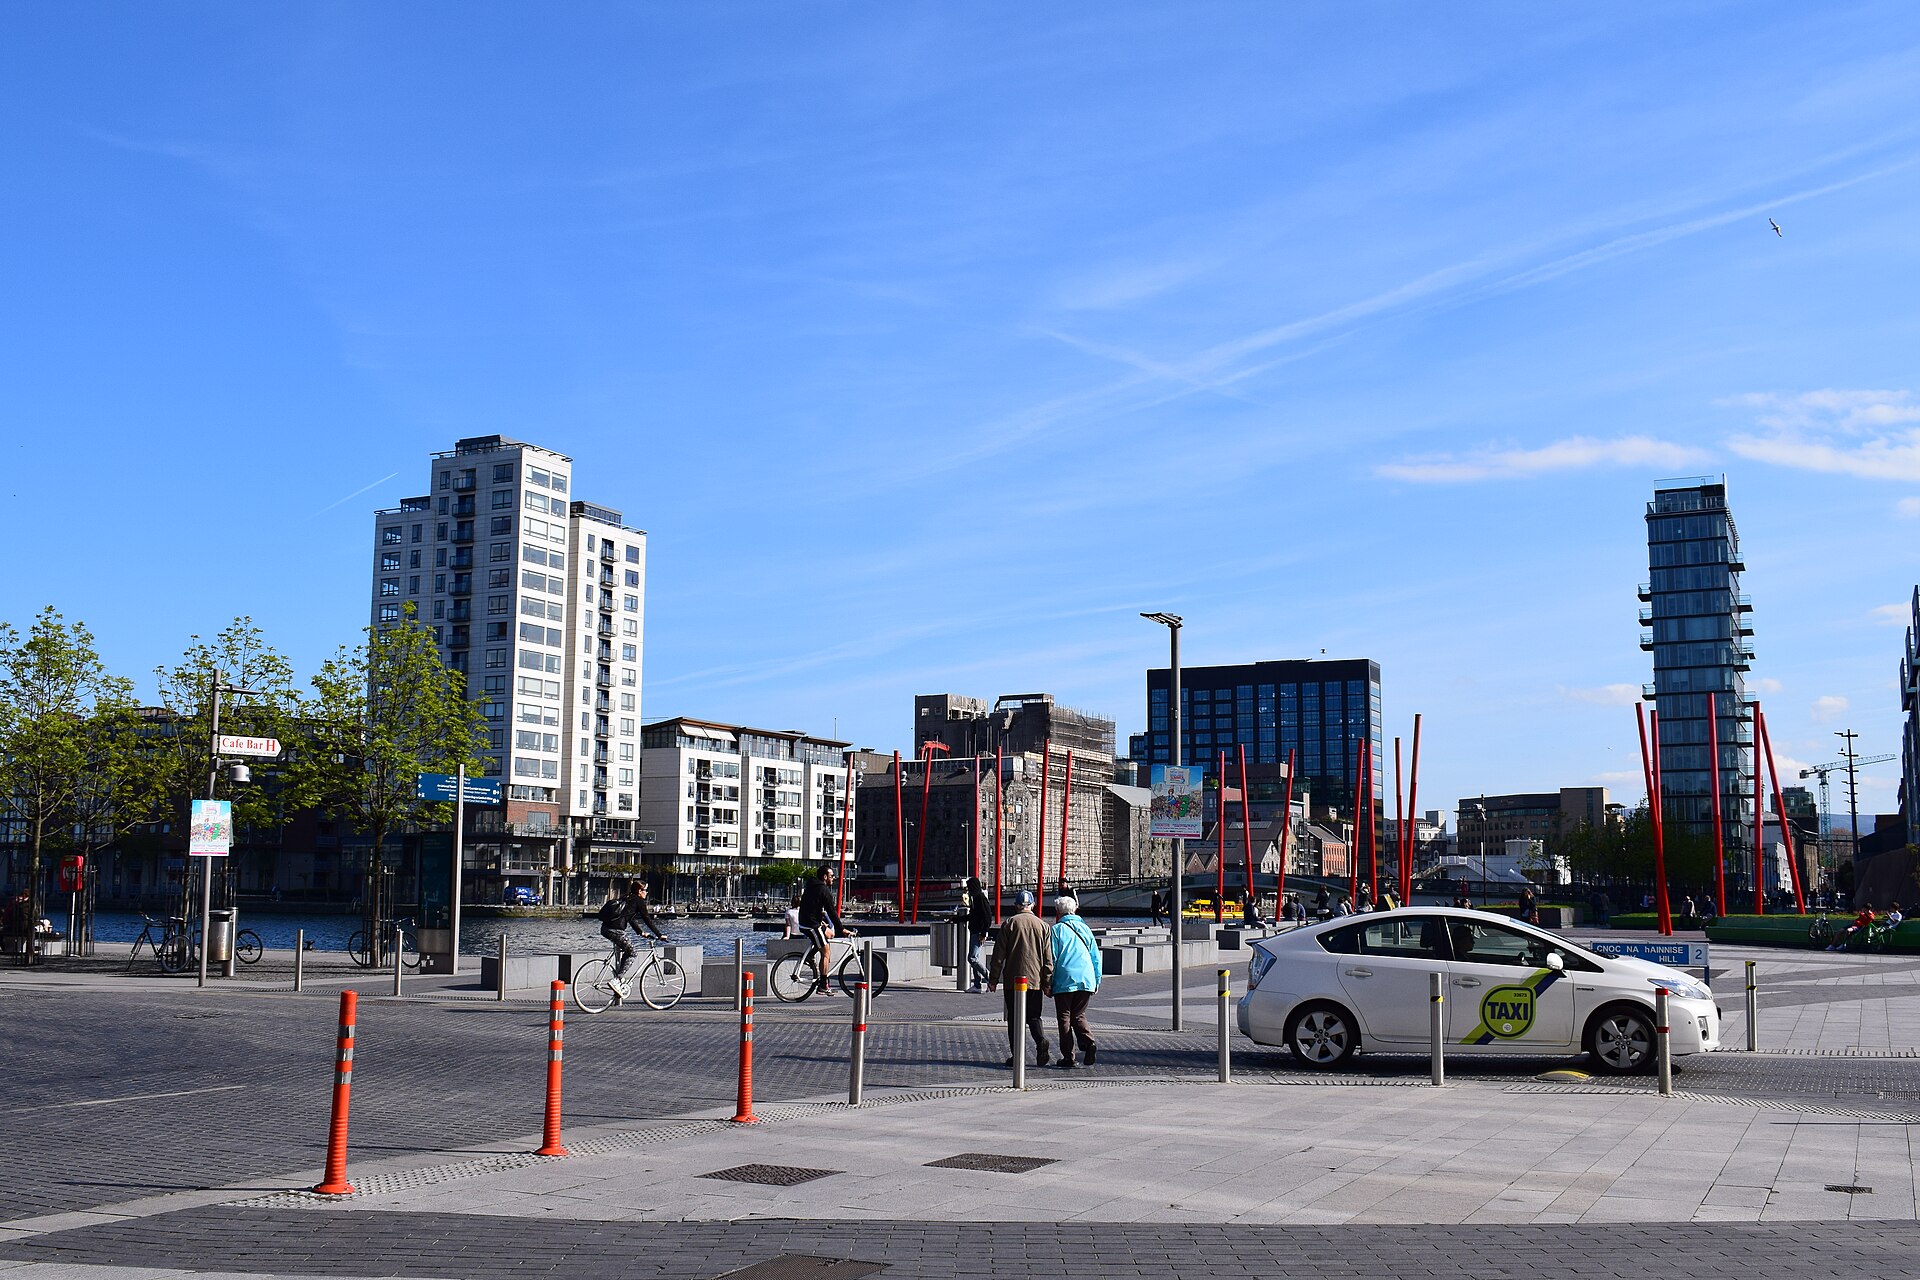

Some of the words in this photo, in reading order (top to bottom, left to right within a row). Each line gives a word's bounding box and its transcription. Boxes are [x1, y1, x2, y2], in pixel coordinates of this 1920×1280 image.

[222, 737, 243, 748] Cafe
[246, 739, 263, 750] Bar
[265, 740, 276, 751] H
[1596, 944, 1621, 953] CNOC
[1626, 945, 1639, 953] NA
[1644, 945, 1684, 954] hAINNISE
[1695, 948, 1703, 960] 2
[1658, 955, 1678, 963] HILL
[1487, 1001, 1529, 1021] TAXI
